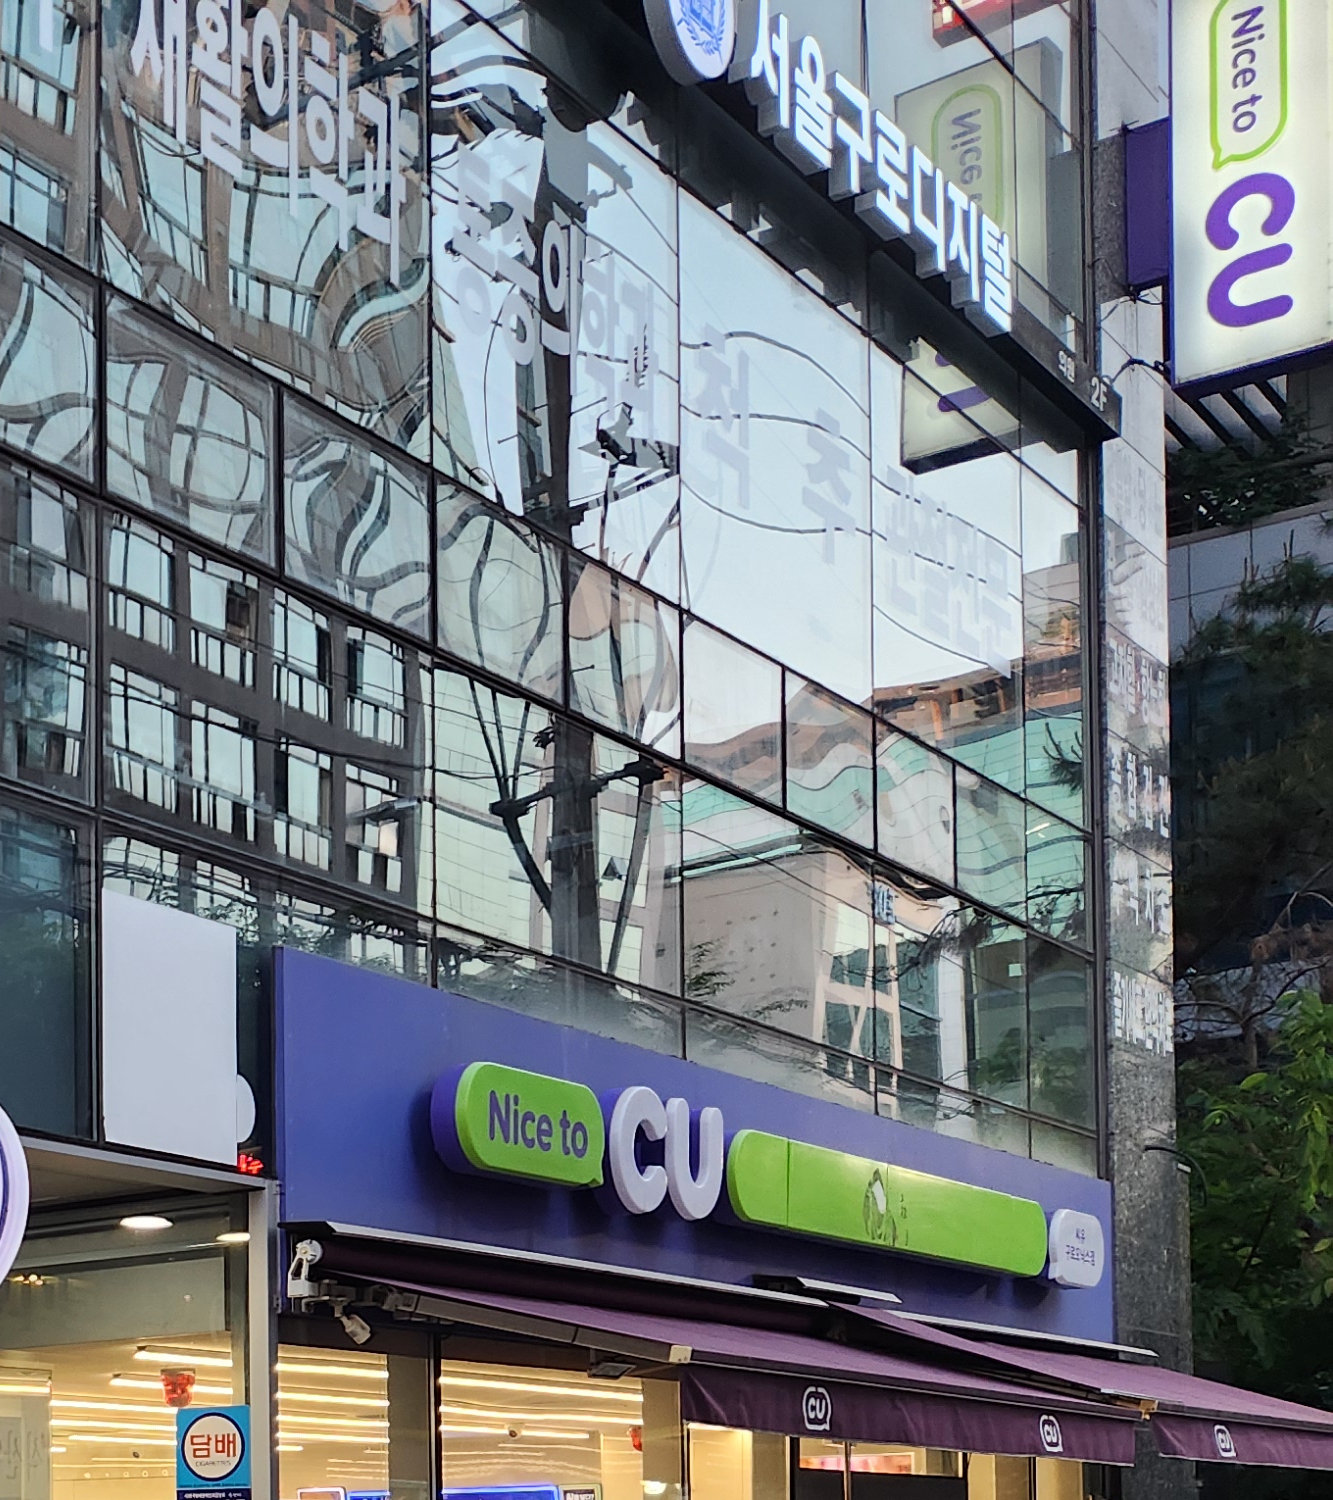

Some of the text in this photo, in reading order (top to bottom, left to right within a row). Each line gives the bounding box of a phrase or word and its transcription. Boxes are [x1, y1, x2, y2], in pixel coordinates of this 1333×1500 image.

[1228, 4, 1265, 135] Nice to
[750, 0, 1013, 333] 서울구로디지털
[1090, 376, 1109, 412] 2F
[1205, 172, 1296, 328] CU
[488, 1088, 589, 1160] Nice to
[608, 1085, 725, 1223] CU
[807, 1397, 827, 1422] CU
[1042, 1423, 1059, 1446] CU
[1217, 1431, 1234, 1452] CU
[190, 1433, 237, 1459] 담배
